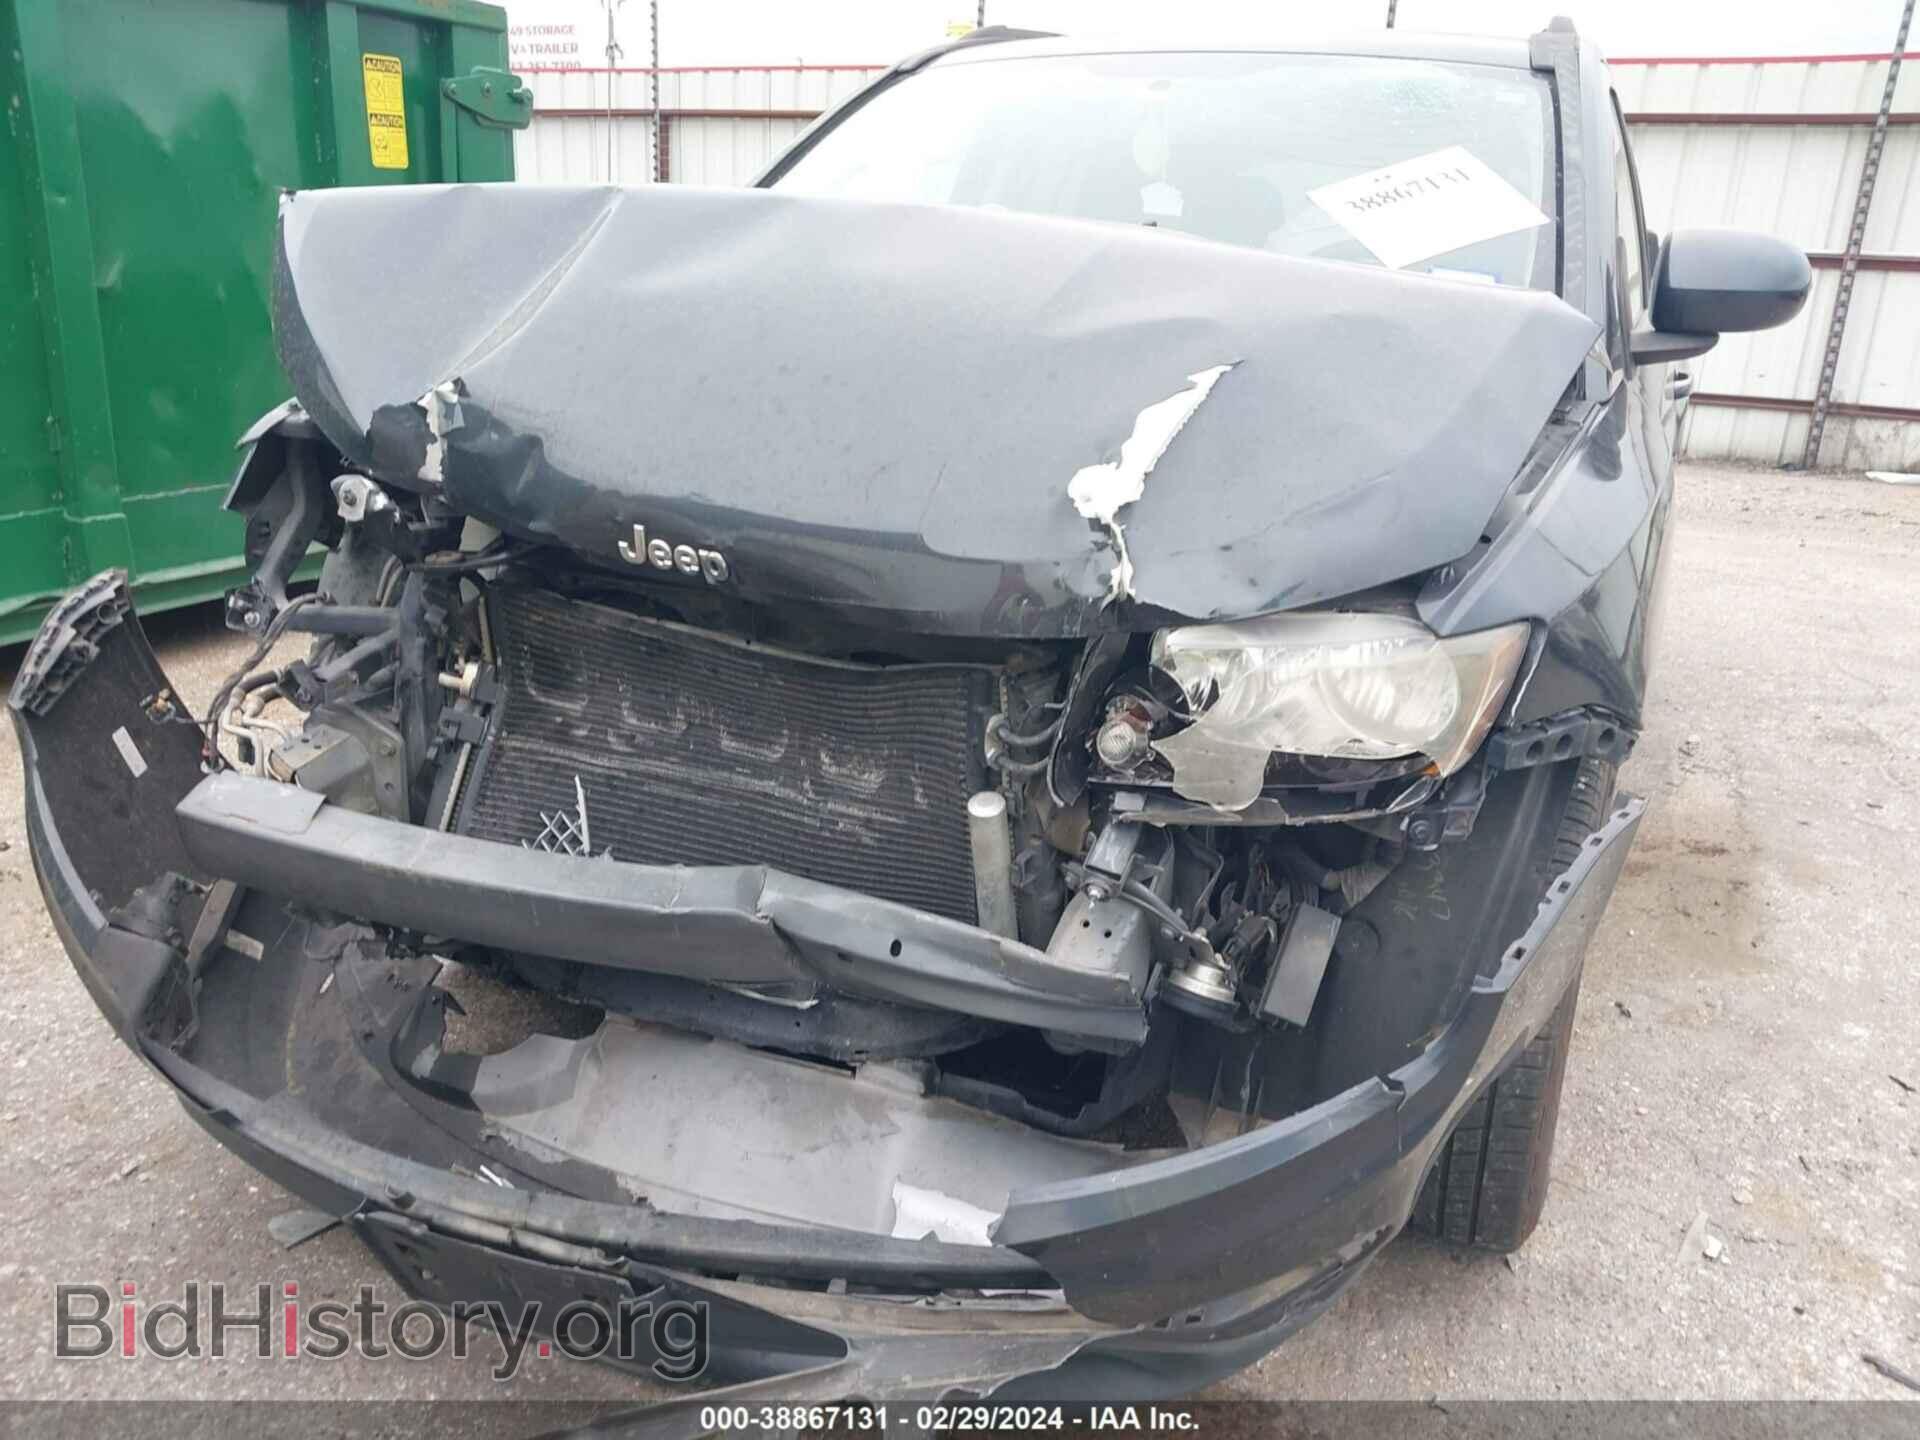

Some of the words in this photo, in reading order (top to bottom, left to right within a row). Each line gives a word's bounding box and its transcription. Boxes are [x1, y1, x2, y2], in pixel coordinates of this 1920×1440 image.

[525, 24, 576, 36] STORAGE
[529, 42, 579, 55] TRAILER
[618, 523, 729, 585] Jeep
